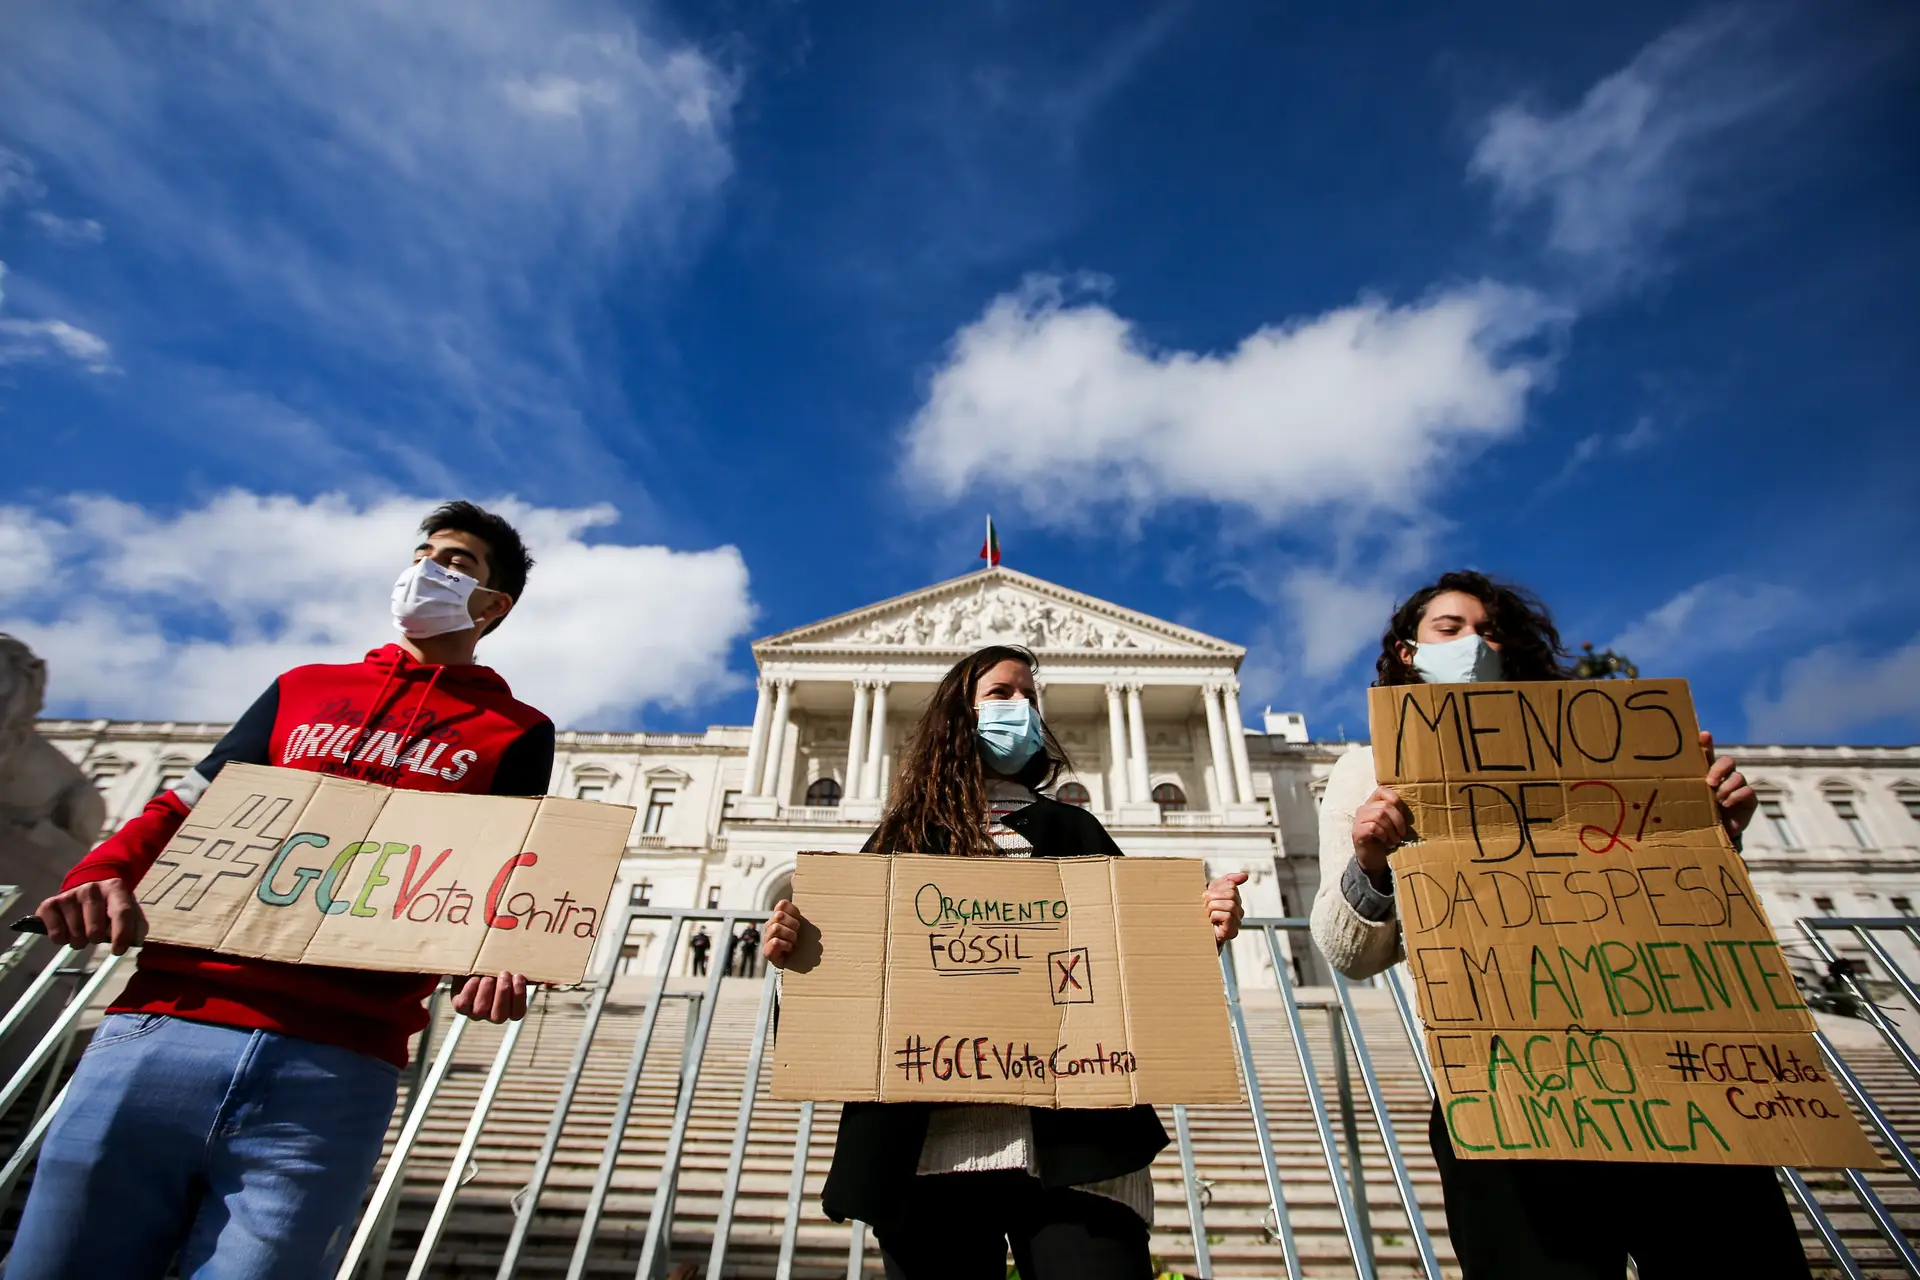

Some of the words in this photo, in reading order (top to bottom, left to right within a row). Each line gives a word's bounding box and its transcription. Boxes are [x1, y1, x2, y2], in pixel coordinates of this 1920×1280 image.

[282, 722, 478, 782] ORIGINALS
[1395, 688, 1683, 778] MENOS
[1458, 781, 1578, 863] DE
[1569, 780, 1663, 854] 2%
[1416, 946, 1516, 1022] EM
[1530, 941, 1809, 1021] AMBIENTE
[1437, 1035, 1488, 1095] E
[1488, 1024, 1637, 1097] AÇÃO
[1666, 1040, 1827, 1084] #GCEVota
[1446, 1095, 1731, 1152] CLIMÁTICA
[1725, 1086, 1840, 1121] Contra
